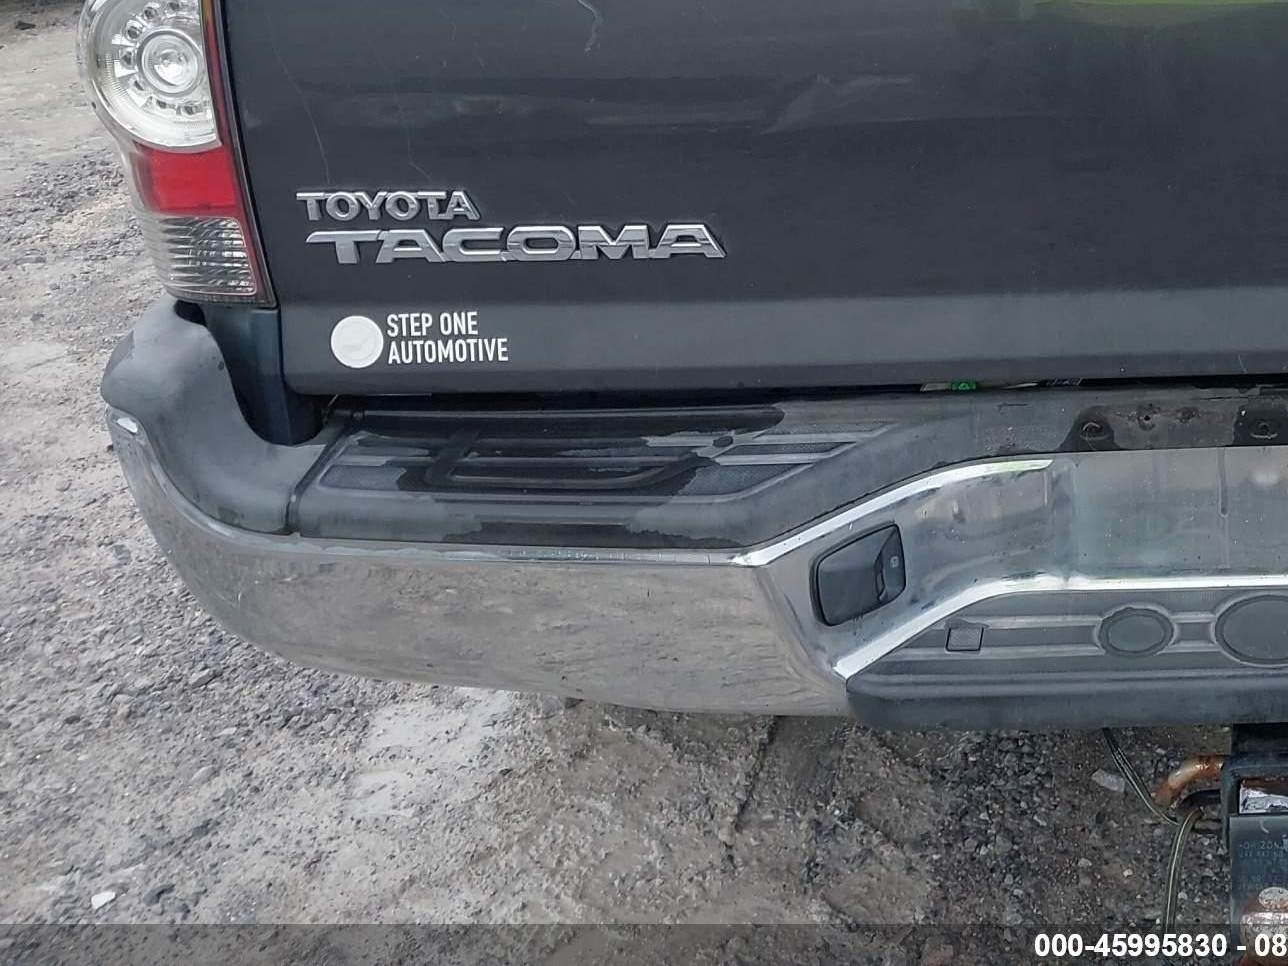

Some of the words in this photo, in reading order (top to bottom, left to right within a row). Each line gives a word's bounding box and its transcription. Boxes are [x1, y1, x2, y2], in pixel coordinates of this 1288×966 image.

[295, 190, 481, 222] TOYOTA
[305, 223, 728, 265] TACOMA
[387, 313, 433, 338] STEP
[441, 311, 479, 336] ONE
[388, 337, 510, 365] AUTOMOTIVE
